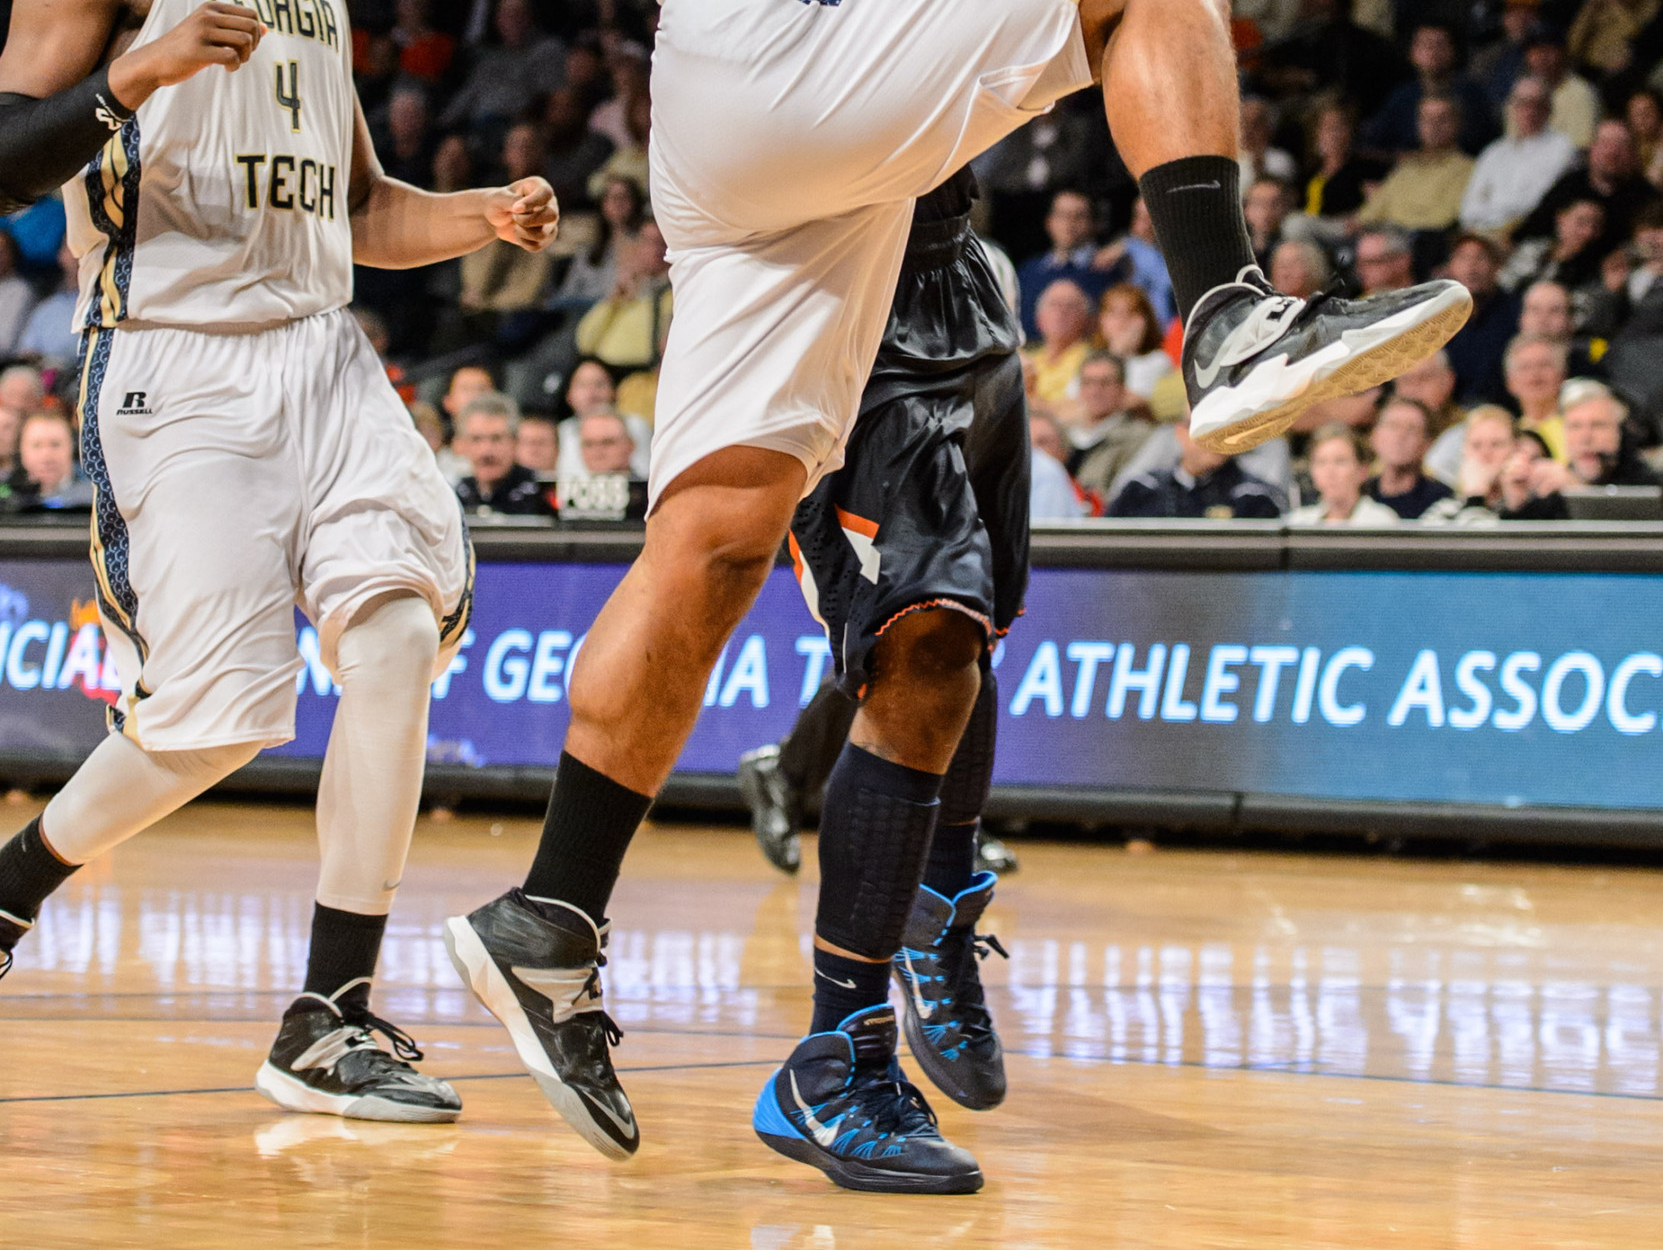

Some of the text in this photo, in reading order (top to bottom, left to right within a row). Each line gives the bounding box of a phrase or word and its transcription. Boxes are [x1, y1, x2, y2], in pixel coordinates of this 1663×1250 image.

[274, 59, 301, 133] 4
[236, 154, 336, 221] TECH
[116, 408, 153, 416] RUSSELL
[1009, 638, 1375, 726] ATHLETIC
[1386, 648, 1663, 735] ASSOC
